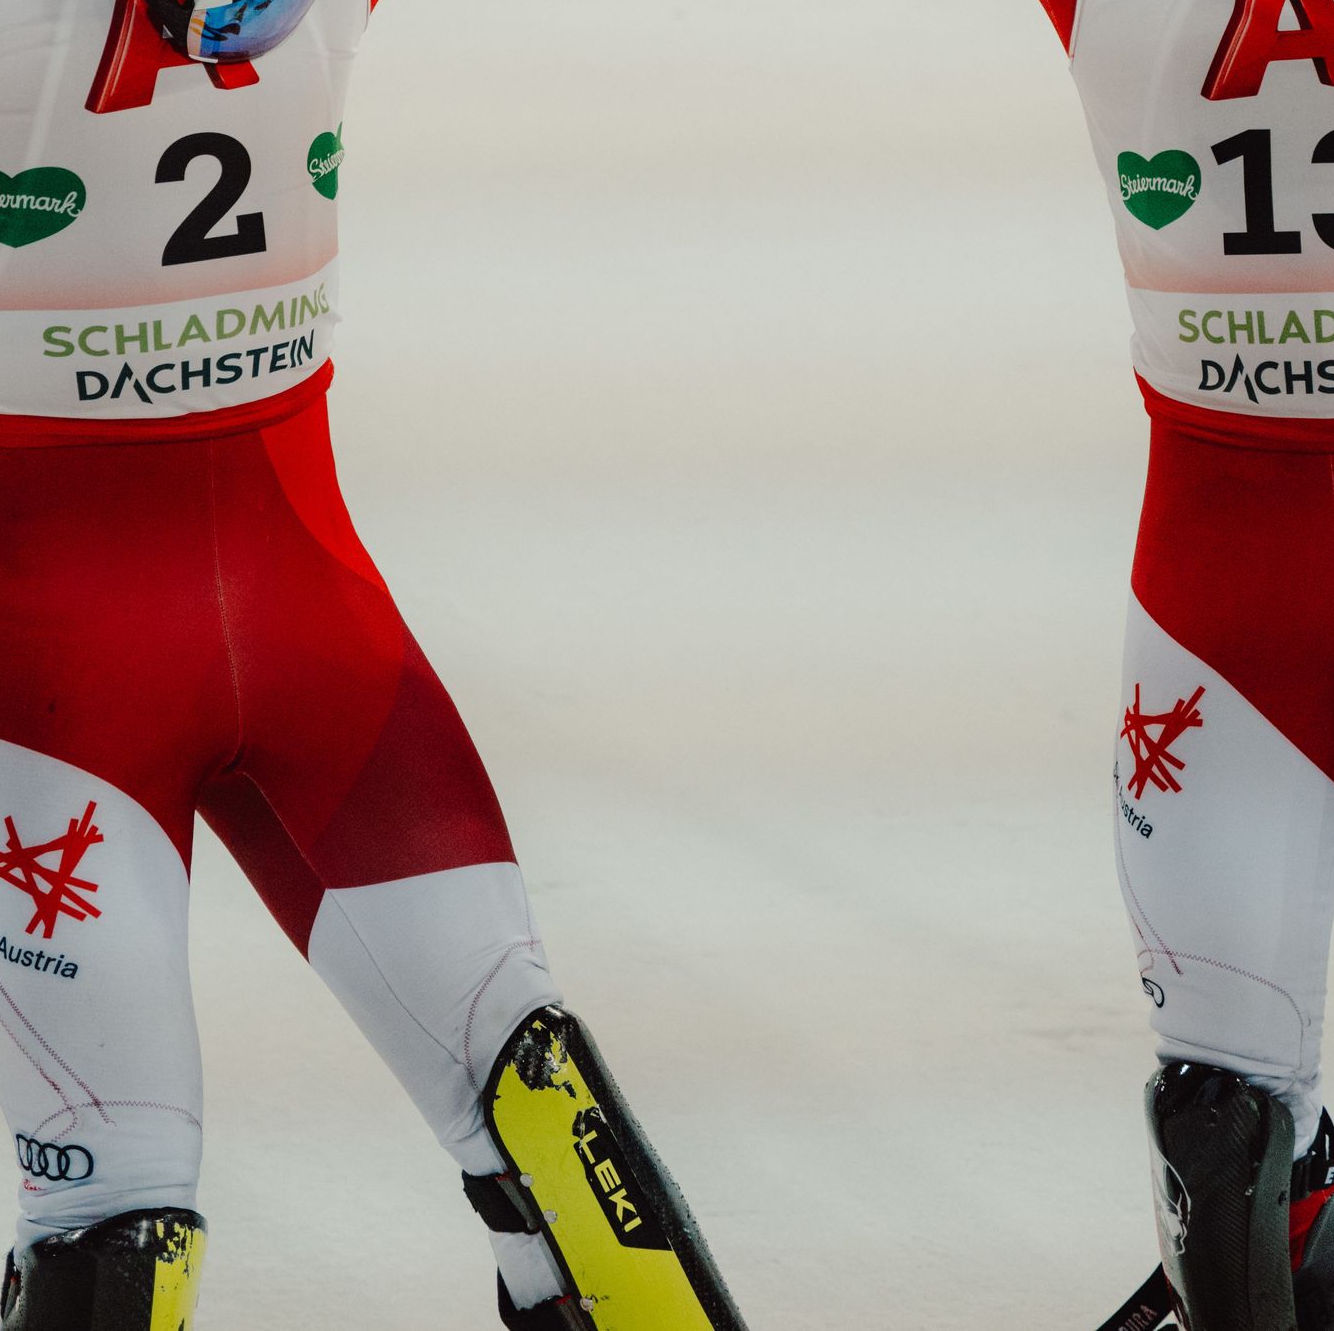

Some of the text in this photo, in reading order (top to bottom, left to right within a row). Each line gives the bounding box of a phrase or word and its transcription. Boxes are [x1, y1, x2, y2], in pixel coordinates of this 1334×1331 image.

[154, 132, 267, 266] 2
[1120, 172, 1201, 202] Steiermark
[42, 282, 331, 358] SCHLADMING
[75, 329, 317, 405] DACHSTEIN
[1118, 784, 1154, 839] stria
[579, 1130, 643, 1233] LEKI
